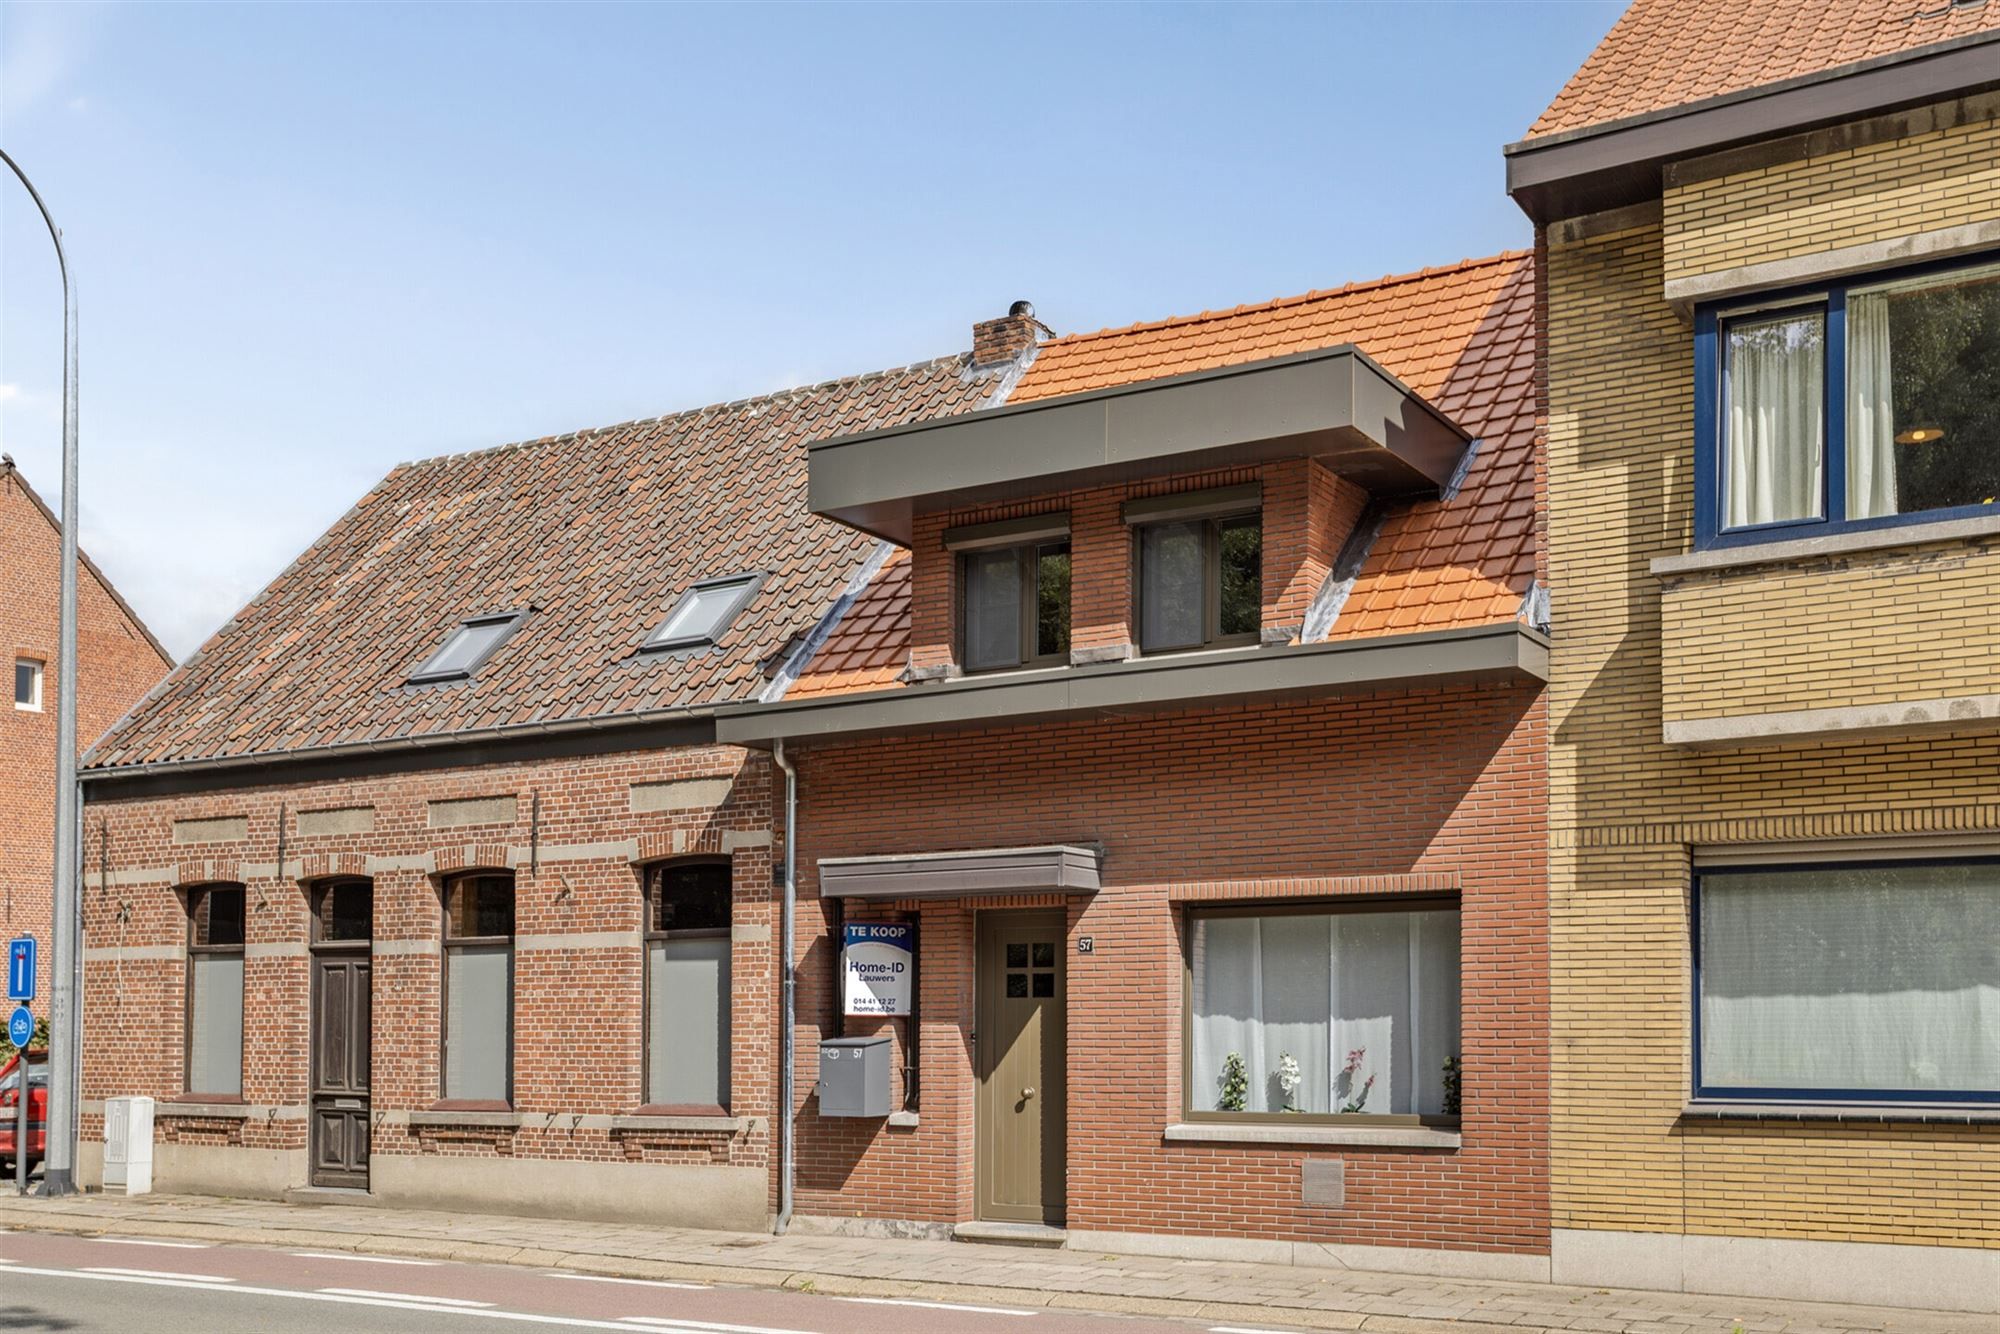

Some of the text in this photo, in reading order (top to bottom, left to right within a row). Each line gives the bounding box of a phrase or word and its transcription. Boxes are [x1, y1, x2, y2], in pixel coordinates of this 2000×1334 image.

[850, 926, 906, 938] TE KOOP
[1079, 939, 1092, 951] 57
[849, 961, 905, 973] Home-ID
[859, 973, 895, 982] Lauwers
[853, 1048, 863, 1059] 57
